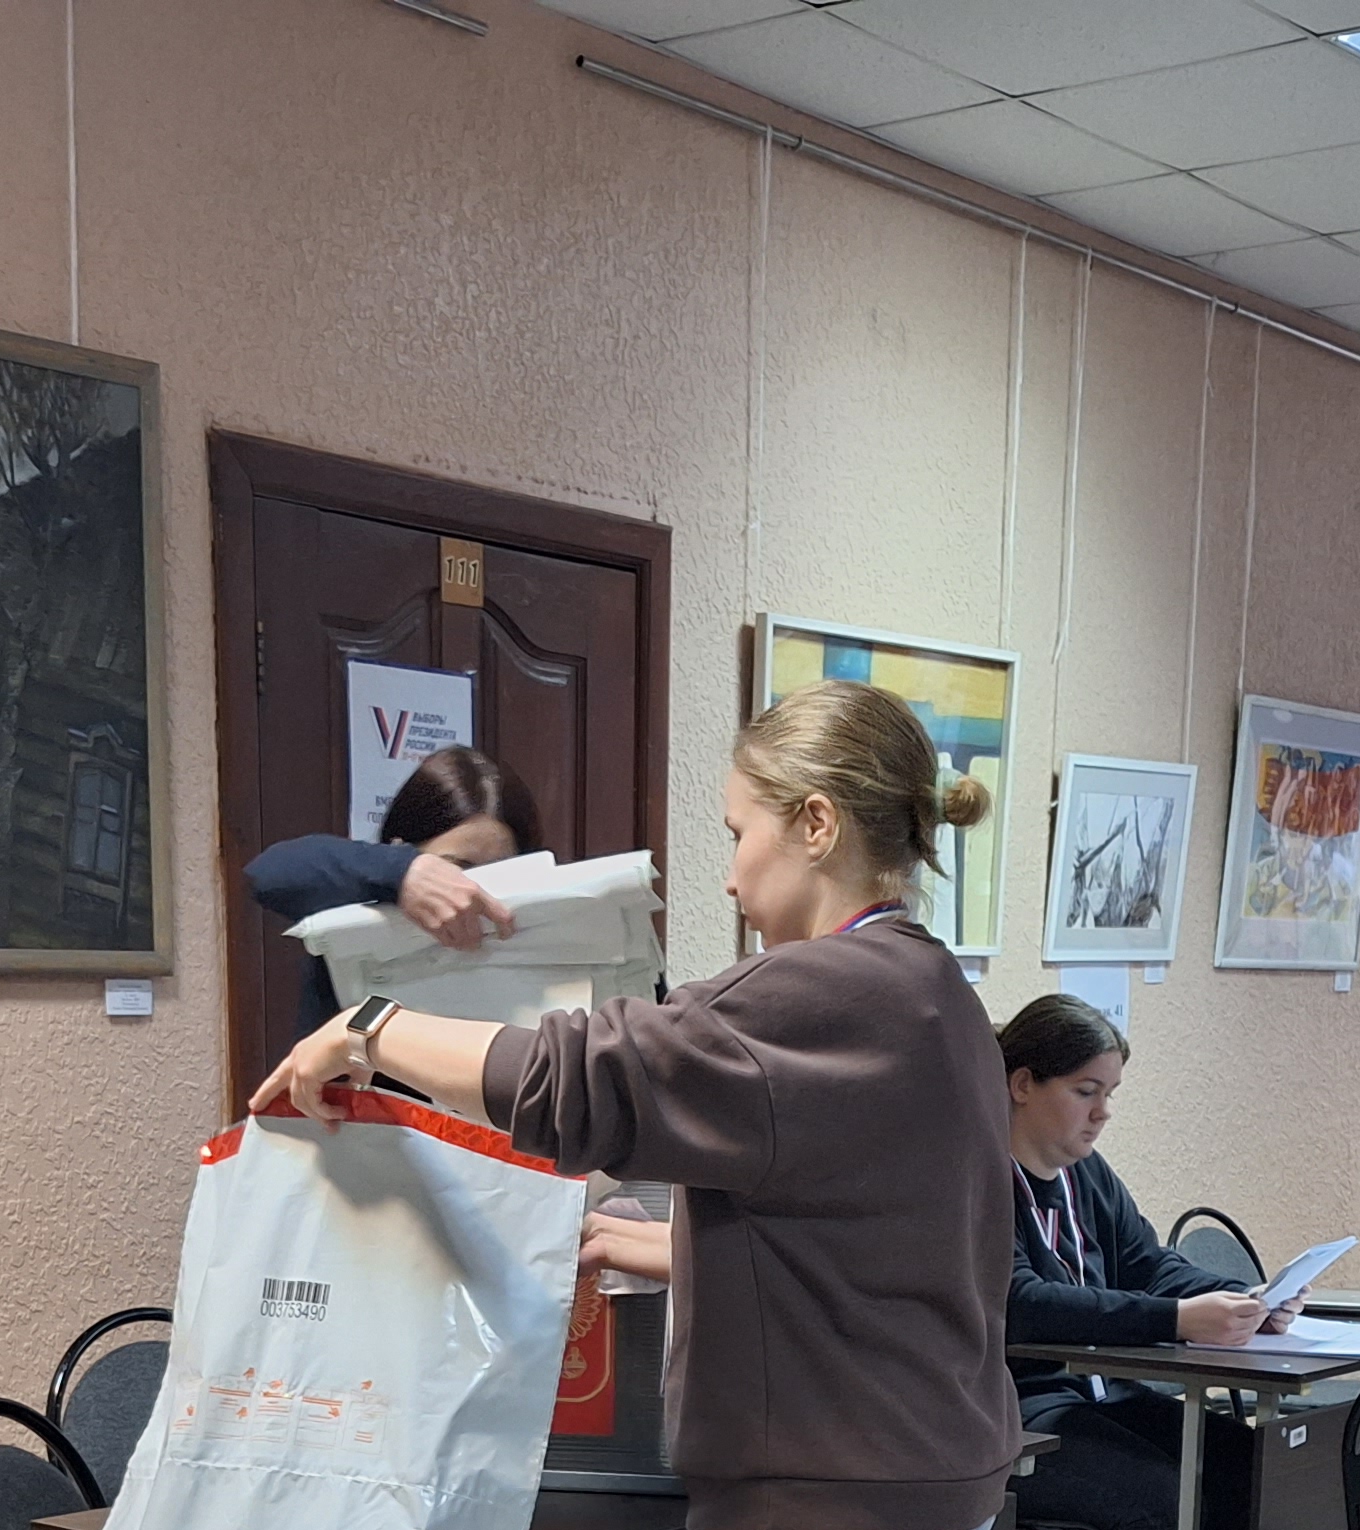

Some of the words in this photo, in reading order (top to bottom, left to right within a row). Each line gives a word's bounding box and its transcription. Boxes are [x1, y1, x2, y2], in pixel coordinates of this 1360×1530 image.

[445, 557, 479, 587] 111
[412, 711, 447, 726] ВЫБОРЫ
[260, 1300, 326, 1322] 003753490
